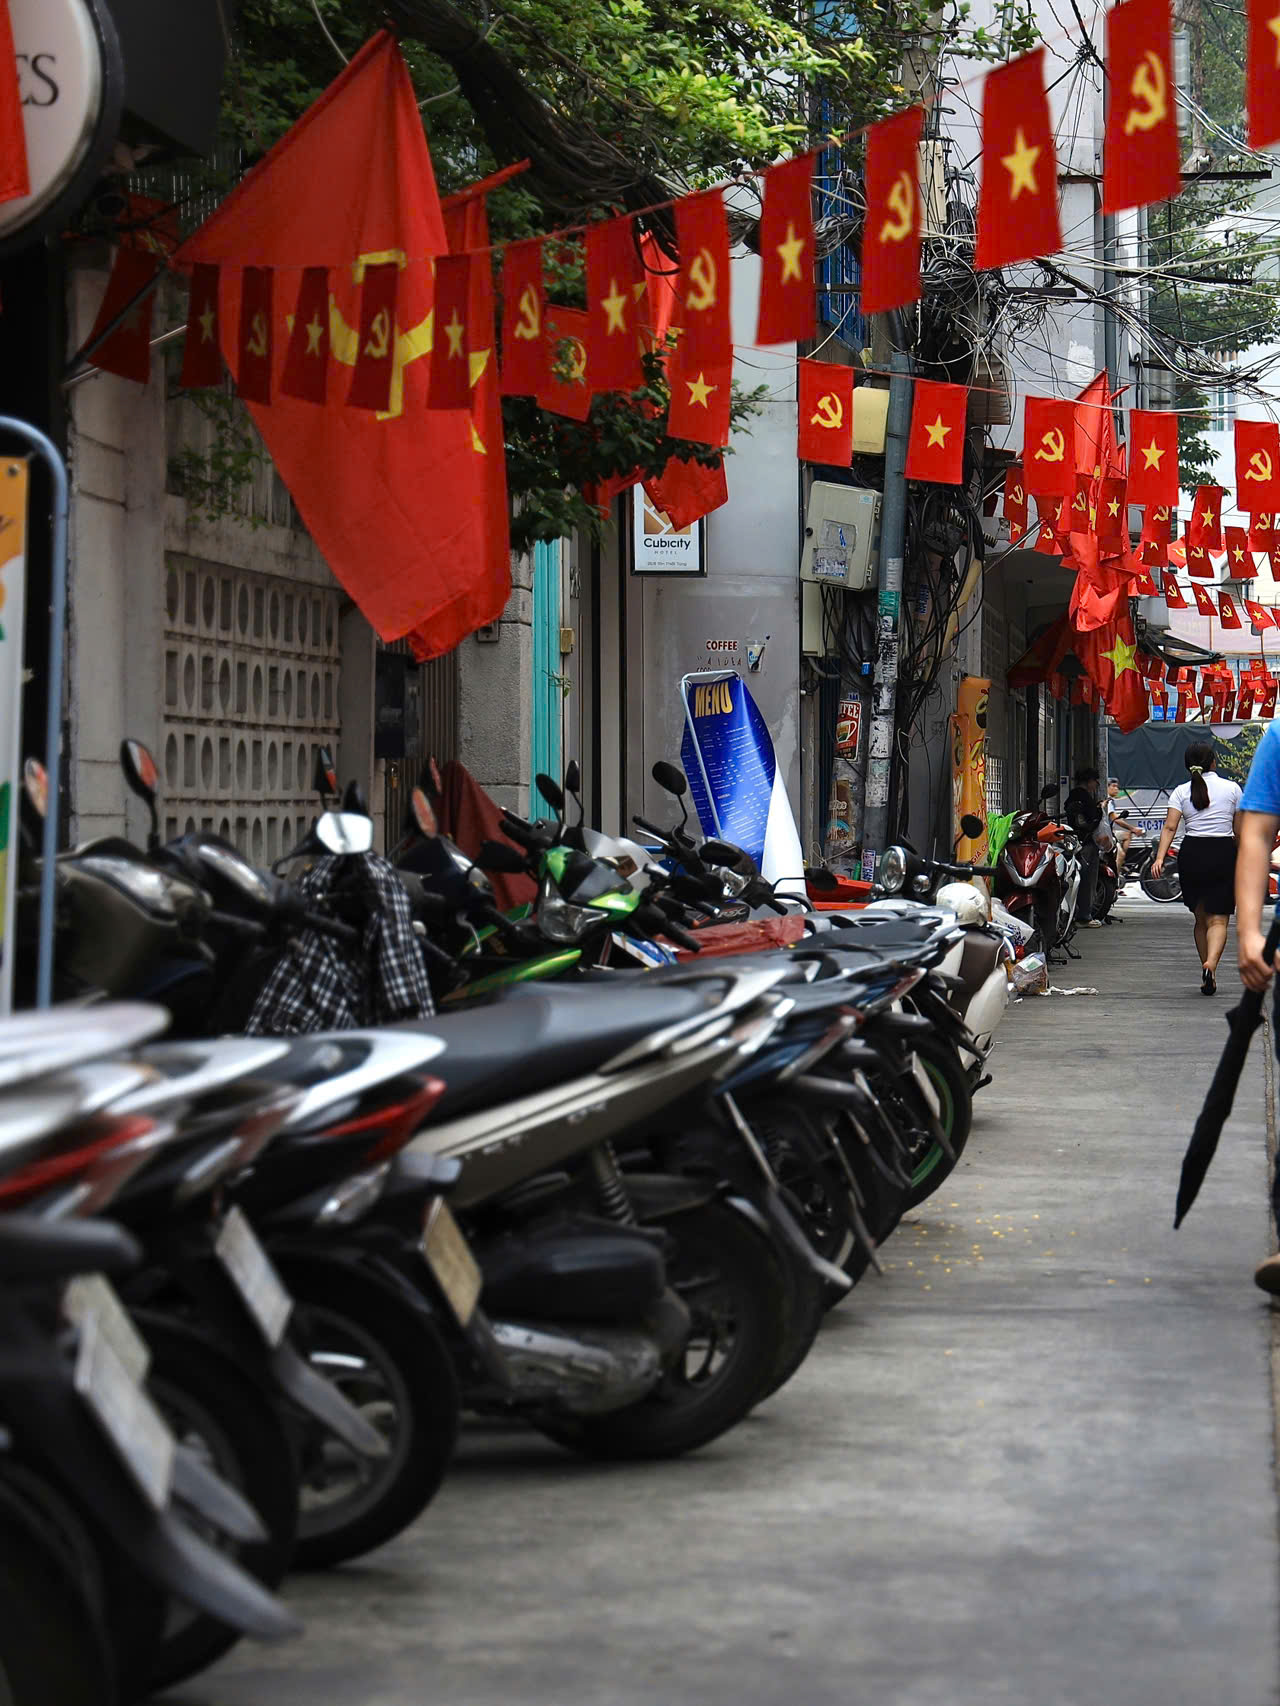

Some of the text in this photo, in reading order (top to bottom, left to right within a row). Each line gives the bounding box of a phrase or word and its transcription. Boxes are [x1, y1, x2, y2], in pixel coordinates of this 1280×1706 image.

[706, 640, 738, 650] COFFEE
[695, 681, 733, 718] MENU
[1138, 819, 1166, 831] 51C-37
